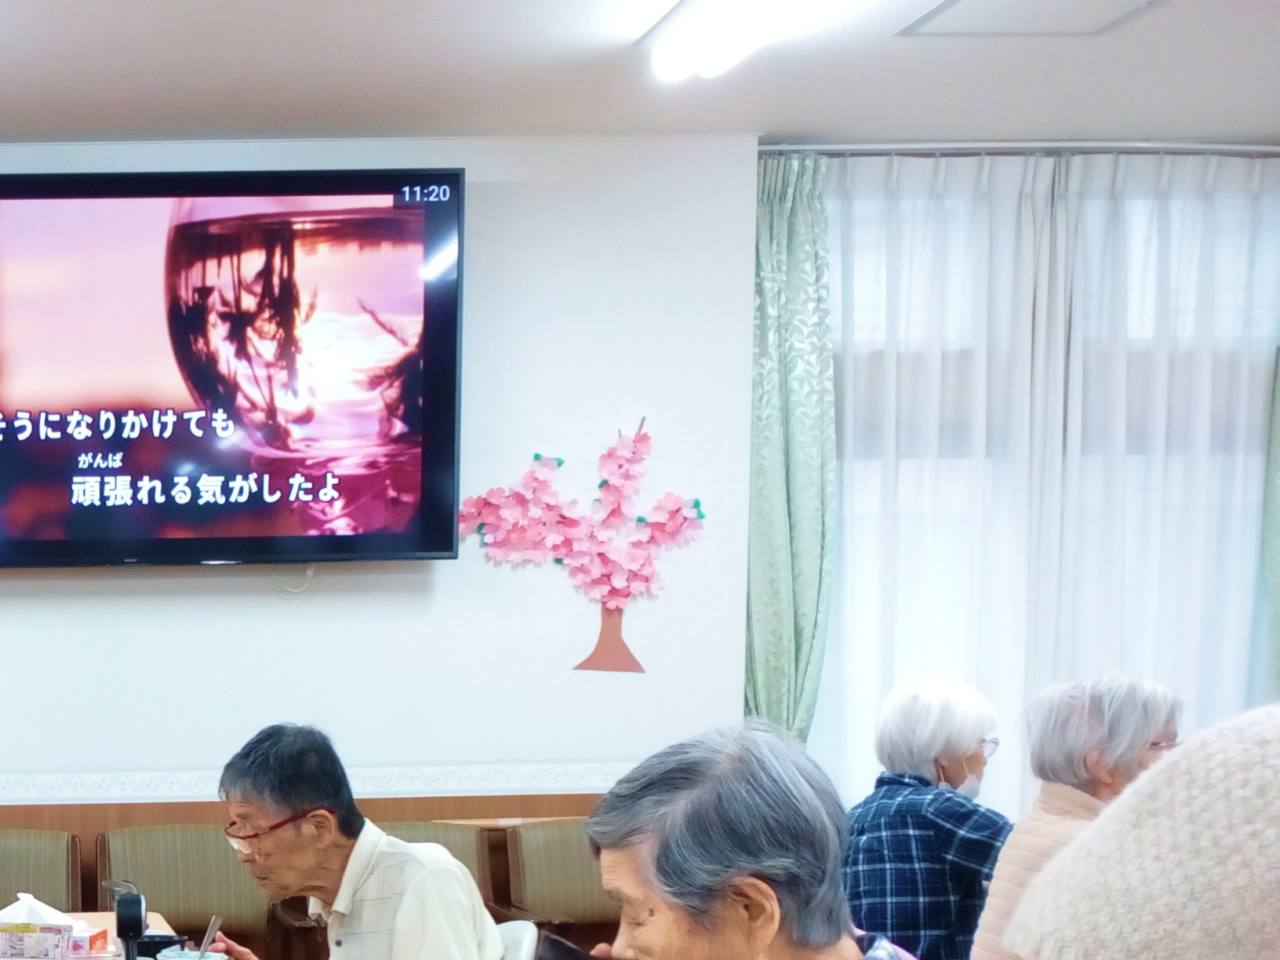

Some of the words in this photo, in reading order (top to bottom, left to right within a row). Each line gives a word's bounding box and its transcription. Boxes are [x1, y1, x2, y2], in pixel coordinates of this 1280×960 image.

[401, 185, 450, 201] 11:20
[77, 452, 124, 469] がんば
[71, 472, 340, 507] 頑張れる気がしたよ
